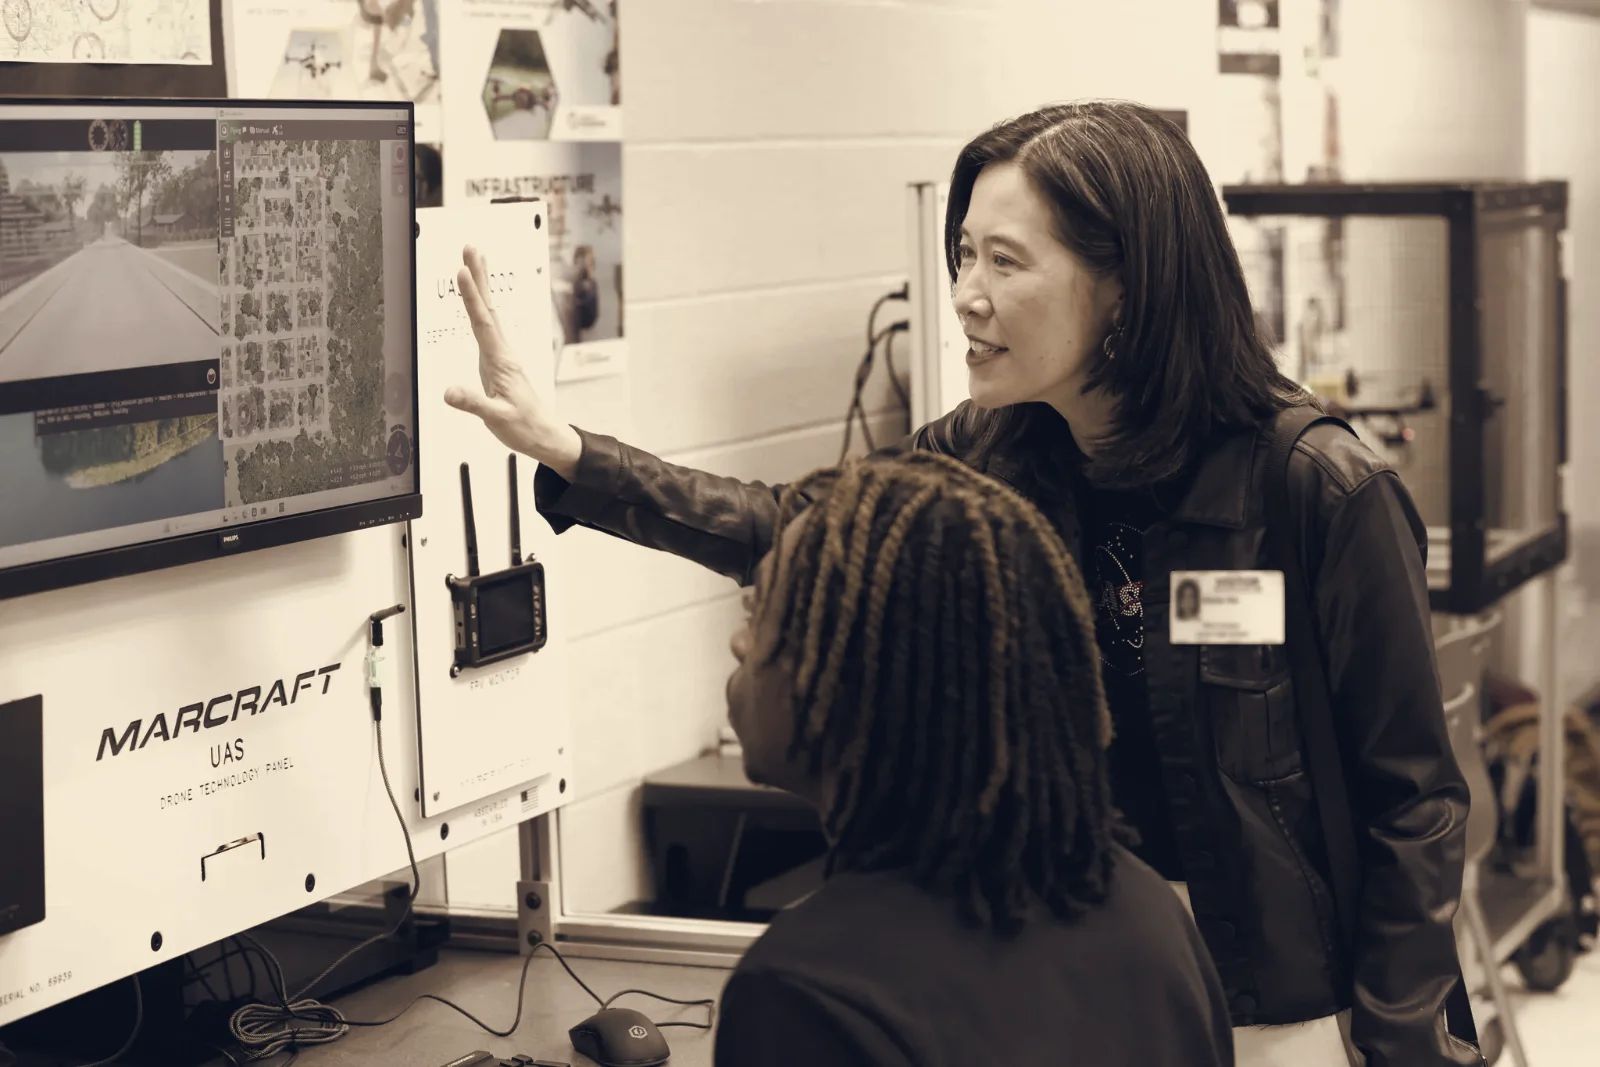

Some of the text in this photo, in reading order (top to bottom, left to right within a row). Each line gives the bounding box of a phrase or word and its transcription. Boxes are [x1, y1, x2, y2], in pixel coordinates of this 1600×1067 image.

[223, 534, 239, 543] PHILIPS
[95, 662, 342, 762] MARCRAFT
[210, 738, 245, 768] UAS
[160, 757, 294, 810] DRONE TECHNOLOGY PANEL
[0, 989, 24, 1008] SERIAL
